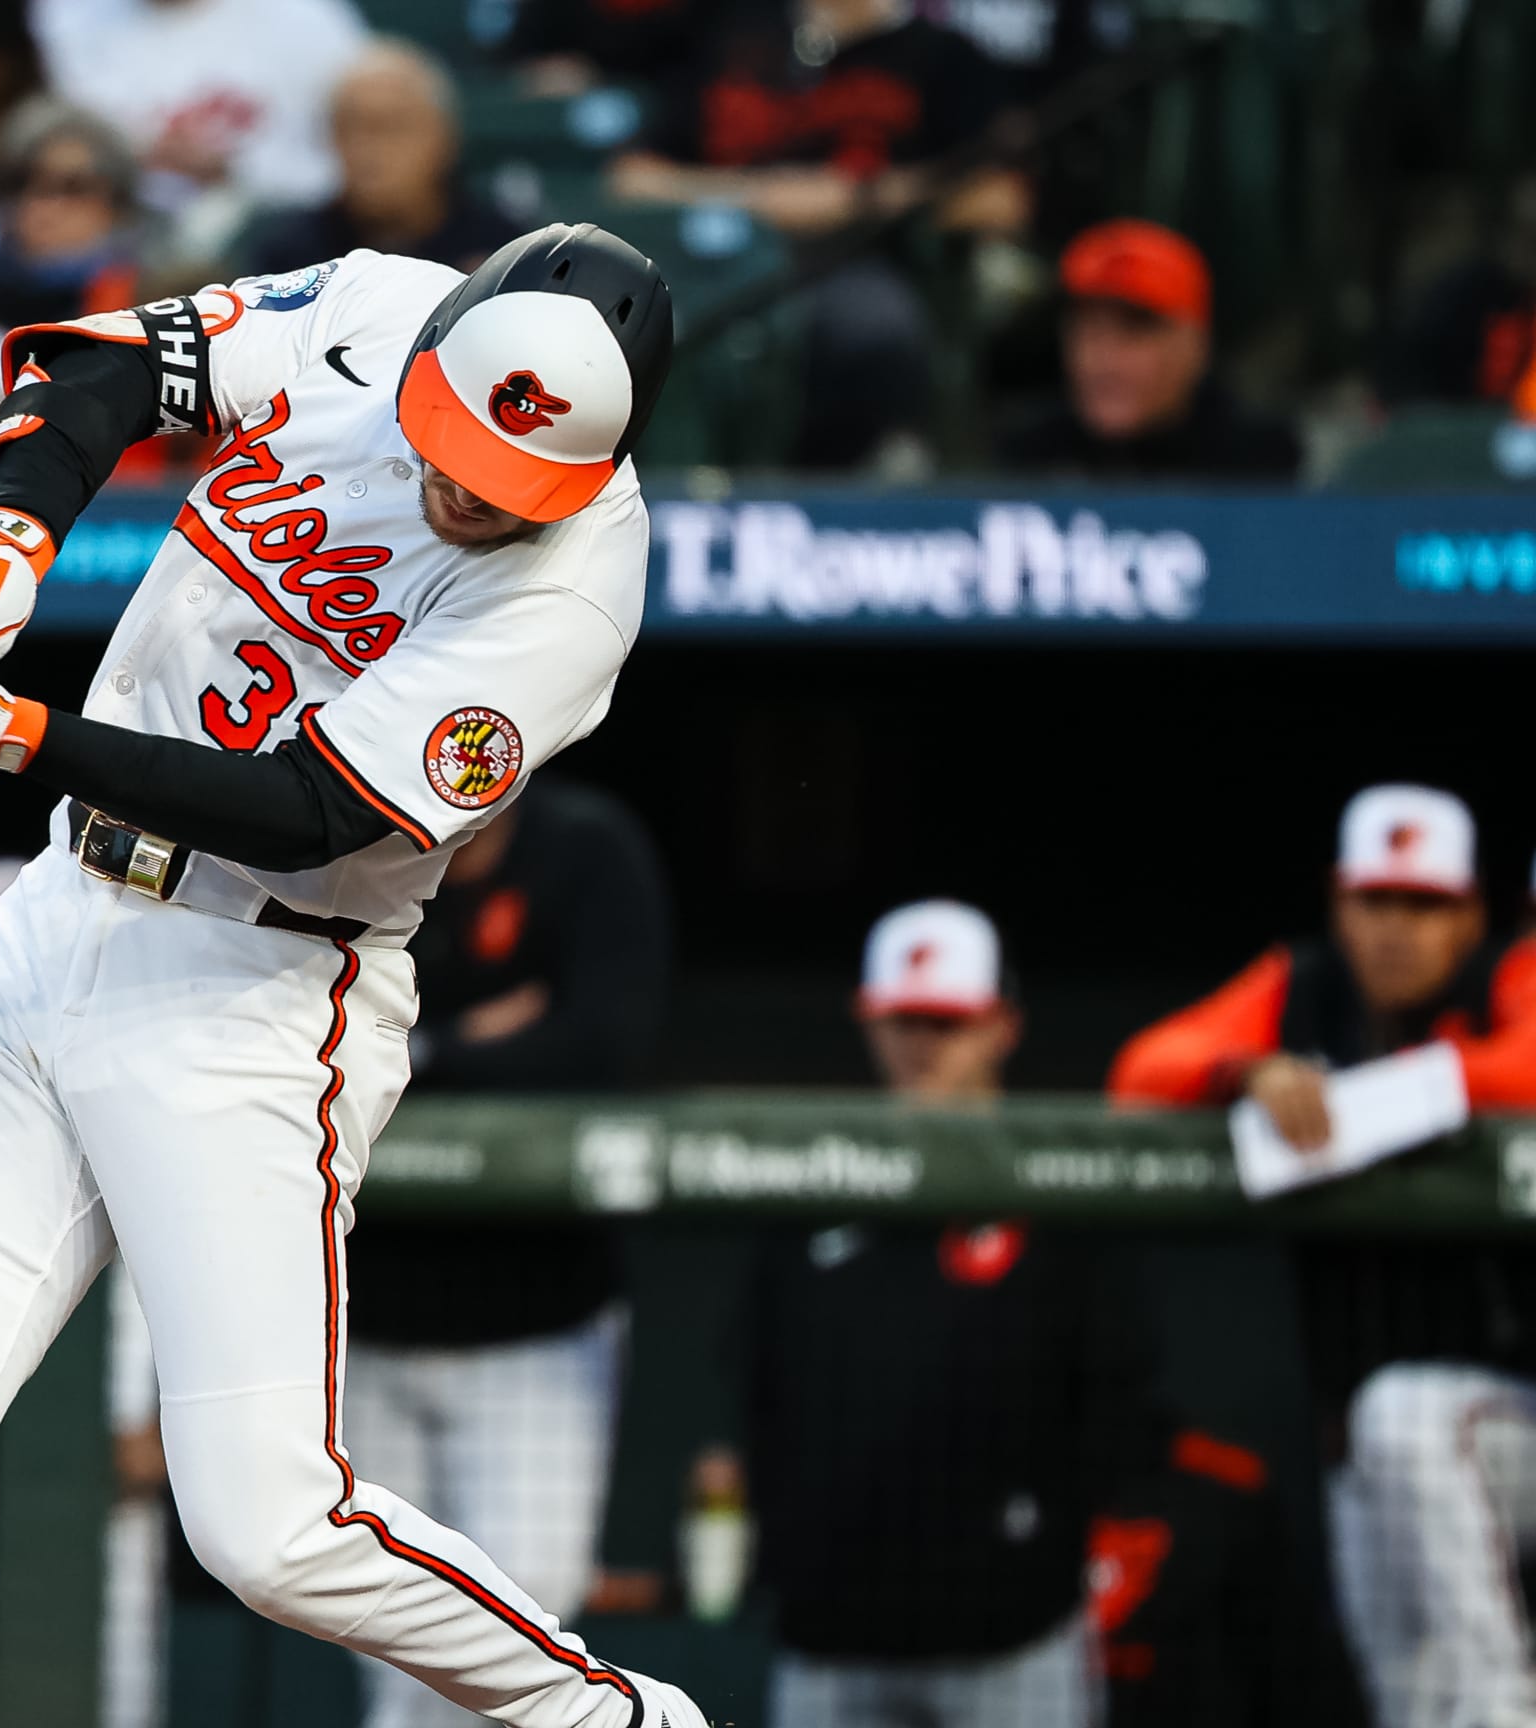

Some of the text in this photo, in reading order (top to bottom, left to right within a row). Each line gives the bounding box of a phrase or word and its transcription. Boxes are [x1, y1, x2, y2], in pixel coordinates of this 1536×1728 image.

[144, 297, 197, 437] O'HEA
[198, 640, 325, 755] 3
[454, 711, 522, 770] BALTIMORE
[428, 758, 481, 806] ORIOLES
